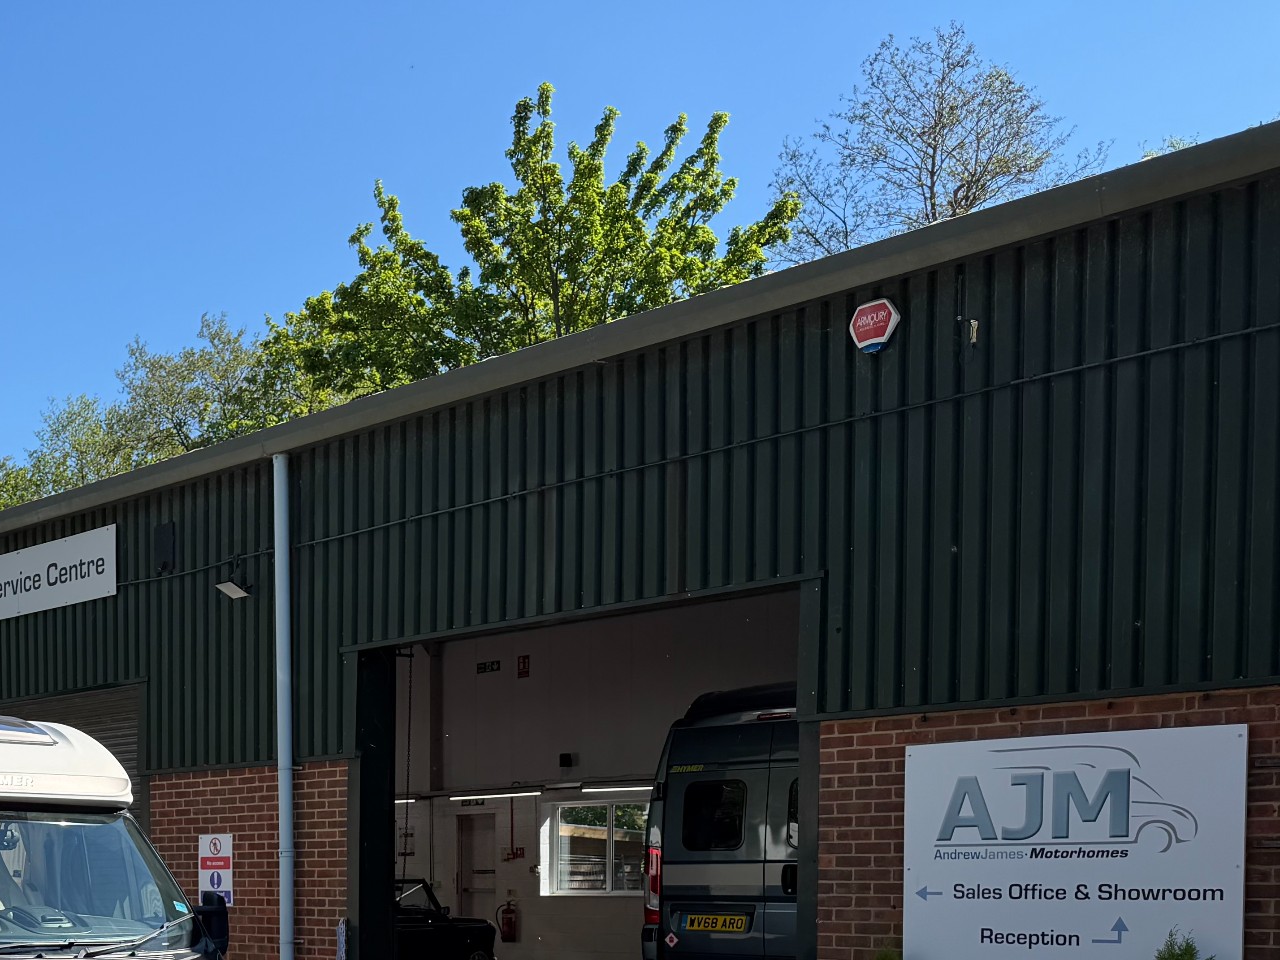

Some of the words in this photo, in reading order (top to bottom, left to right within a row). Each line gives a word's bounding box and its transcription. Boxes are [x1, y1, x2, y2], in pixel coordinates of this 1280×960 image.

[856, 310, 888, 327] ARMOURY
[46, 557, 105, 586] Centre
[935, 768, 1131, 842] AJM
[952, 883, 1003, 900] Sales
[1008, 883, 1067, 900] Office
[1074, 884, 1091, 900] &
[1097, 883, 1225, 901] Showroom
[688, 916, 718, 929] WV68
[979, 928, 1080, 949] Reception
